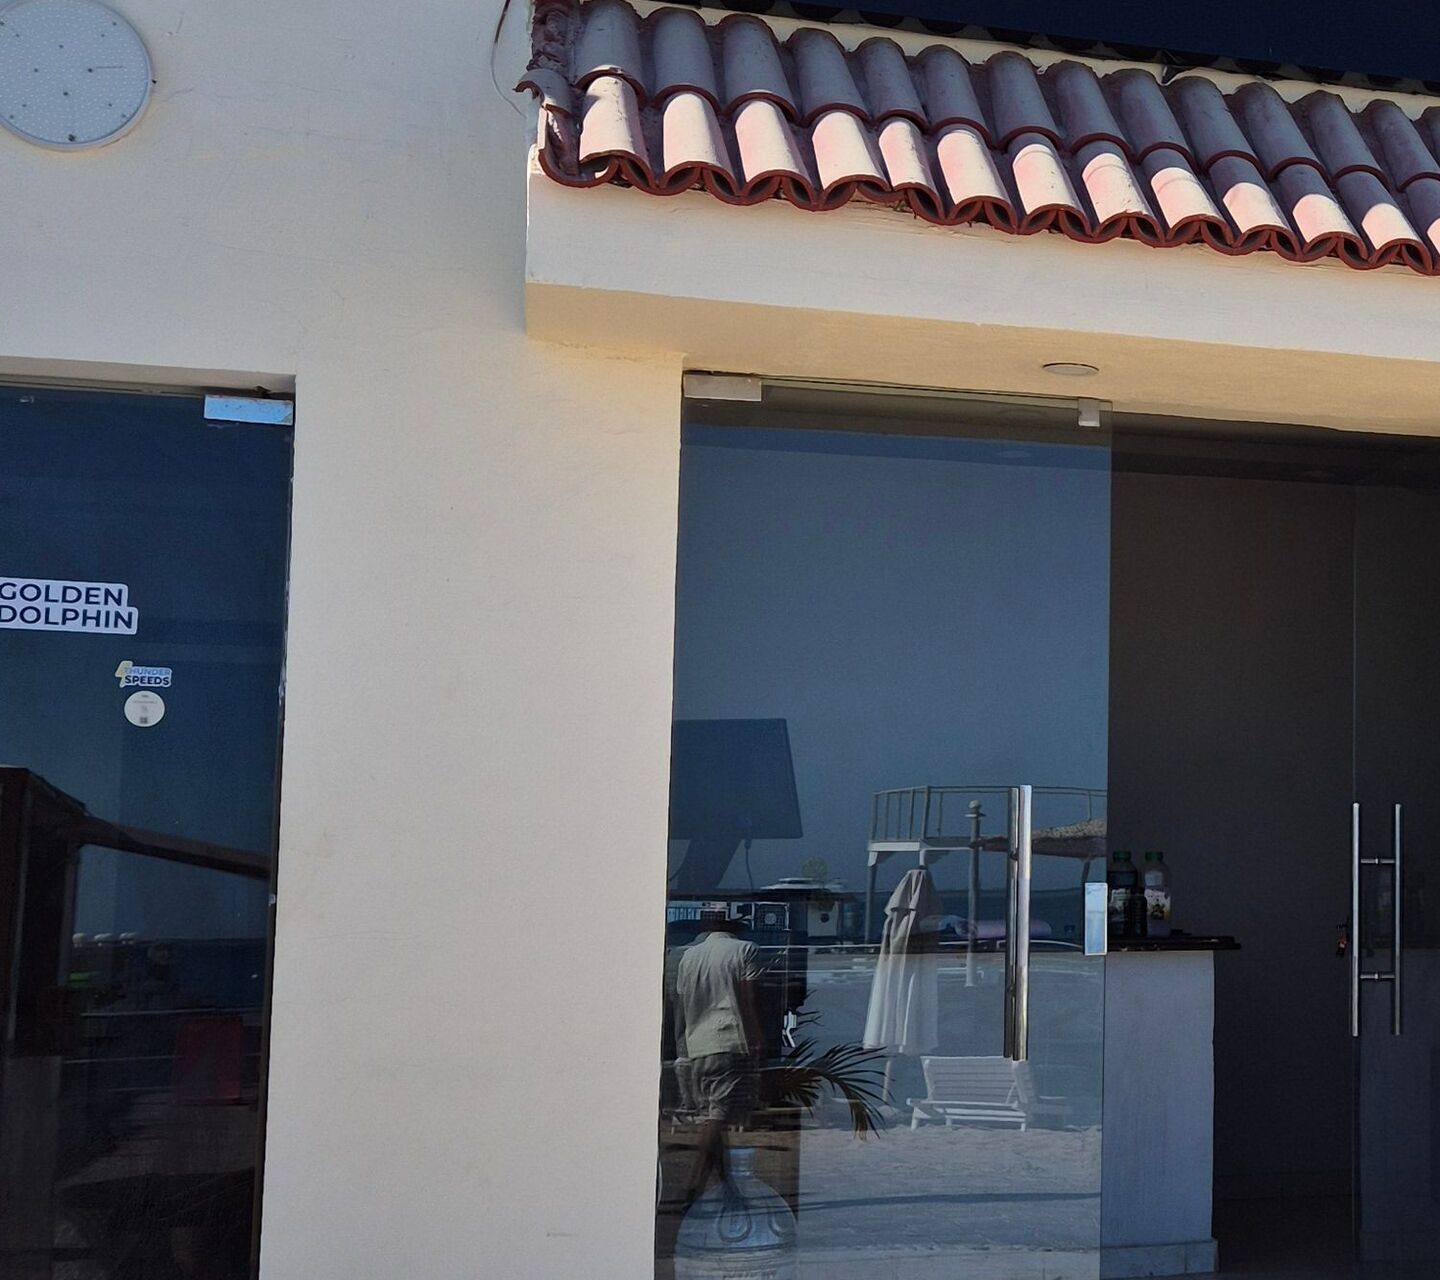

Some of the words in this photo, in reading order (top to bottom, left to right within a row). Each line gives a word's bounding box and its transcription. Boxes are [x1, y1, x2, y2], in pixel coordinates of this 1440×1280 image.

[0, 582, 123, 607] GOLDEN
[0, 604, 133, 629] DOLPHIN
[125, 675, 169, 686] SPEEDS
